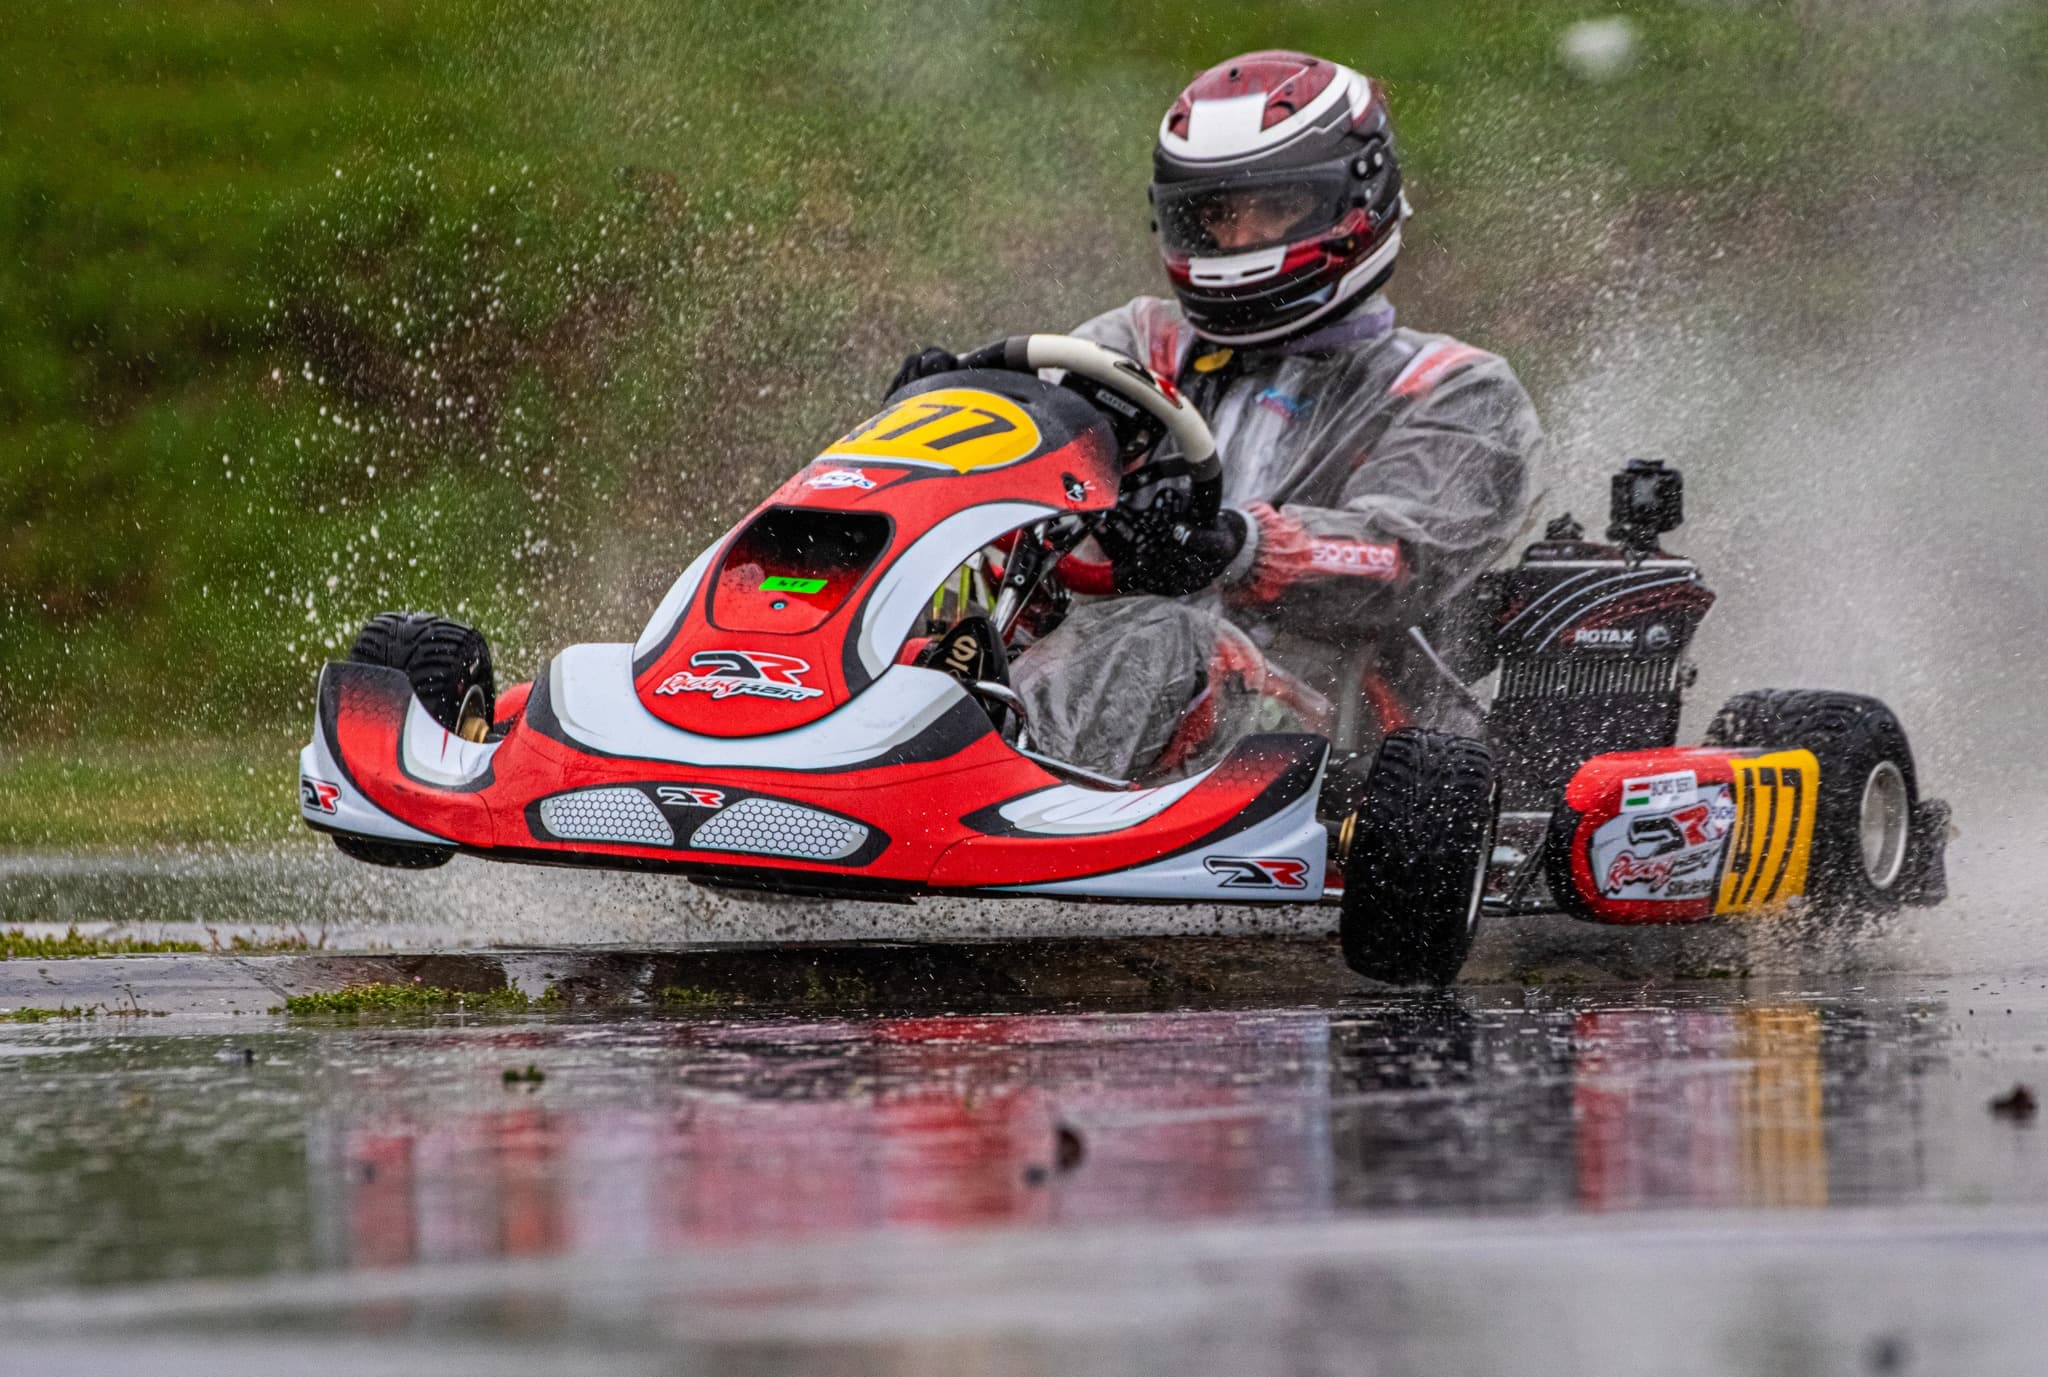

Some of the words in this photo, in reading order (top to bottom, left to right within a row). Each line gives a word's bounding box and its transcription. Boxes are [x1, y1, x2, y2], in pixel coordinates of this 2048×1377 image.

[1574, 629, 1635, 644] ROTAX
[692, 651, 808, 686] DR
[659, 674, 738, 698] Racing
[1728, 767, 1802, 906] 477
[1206, 858, 1307, 887] DR
